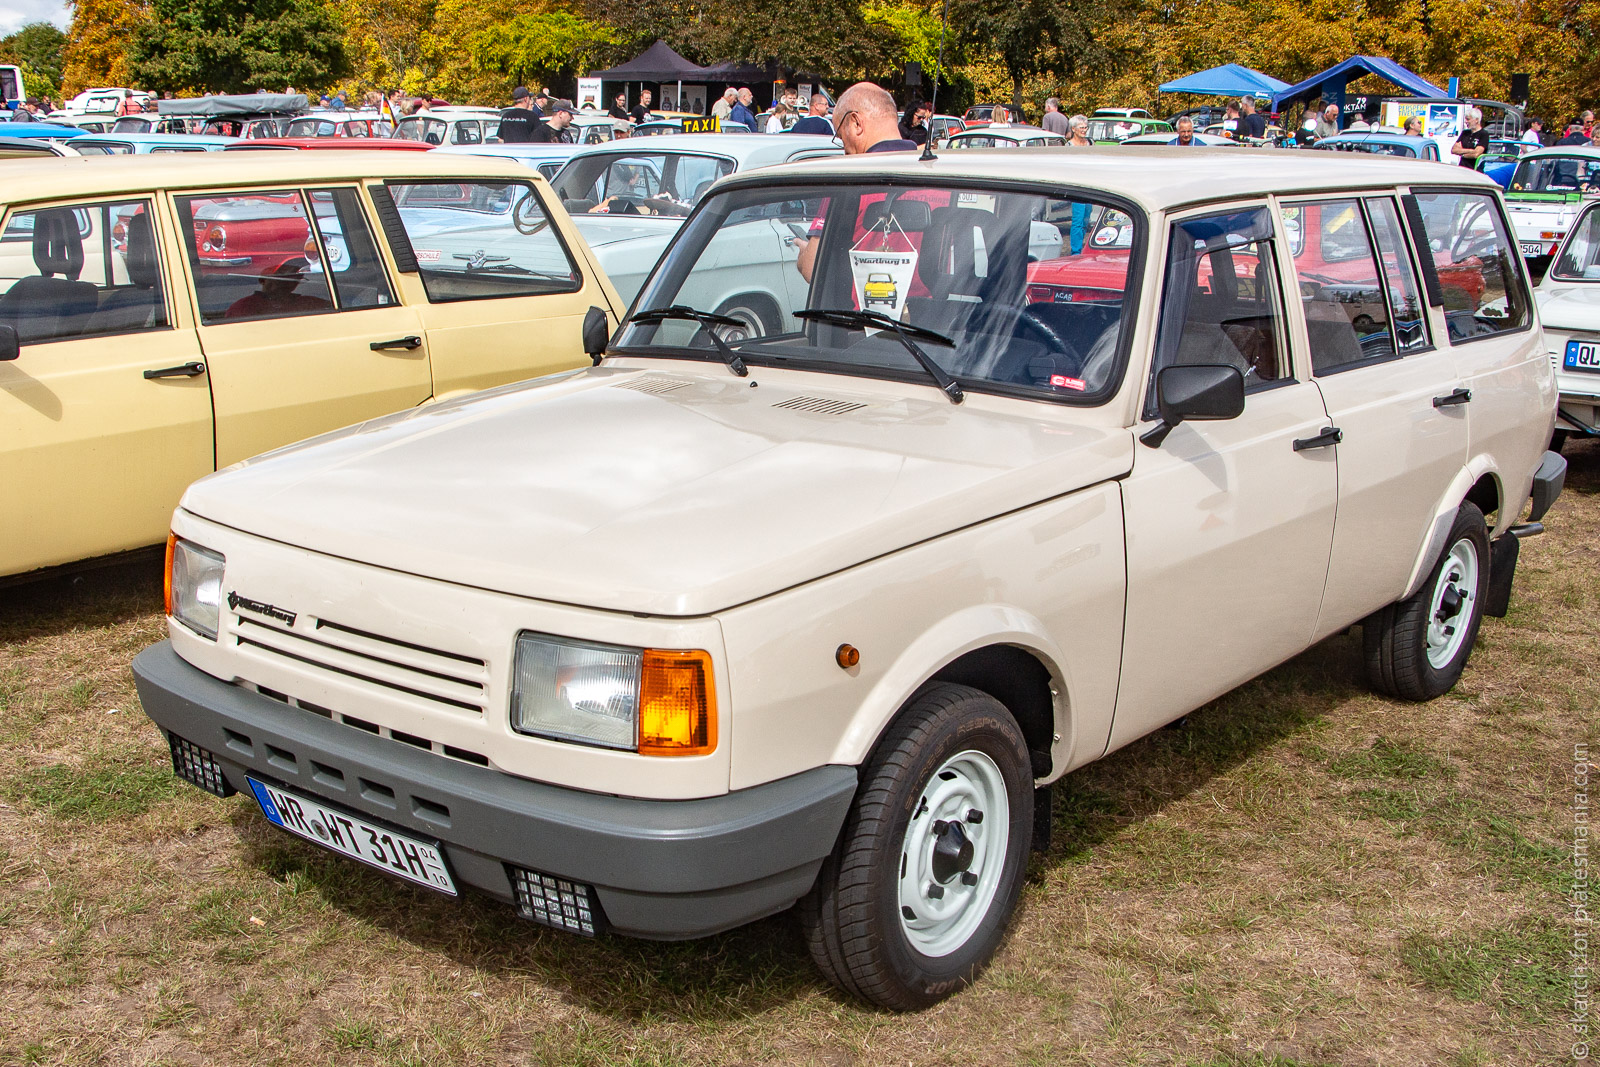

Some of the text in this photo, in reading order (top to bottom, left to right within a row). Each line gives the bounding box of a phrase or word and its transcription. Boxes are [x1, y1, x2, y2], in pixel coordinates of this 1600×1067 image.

[1356, 97, 1367, 105] 79
[1343, 103, 1366, 112] KTAN
[683, 120, 715, 133] TAXI
[1520, 244, 1540, 254] 504
[236, 595, 298, 628] Wartburg
[266, 804, 275, 815] D
[268, 789, 430, 880] WR WT 31H
